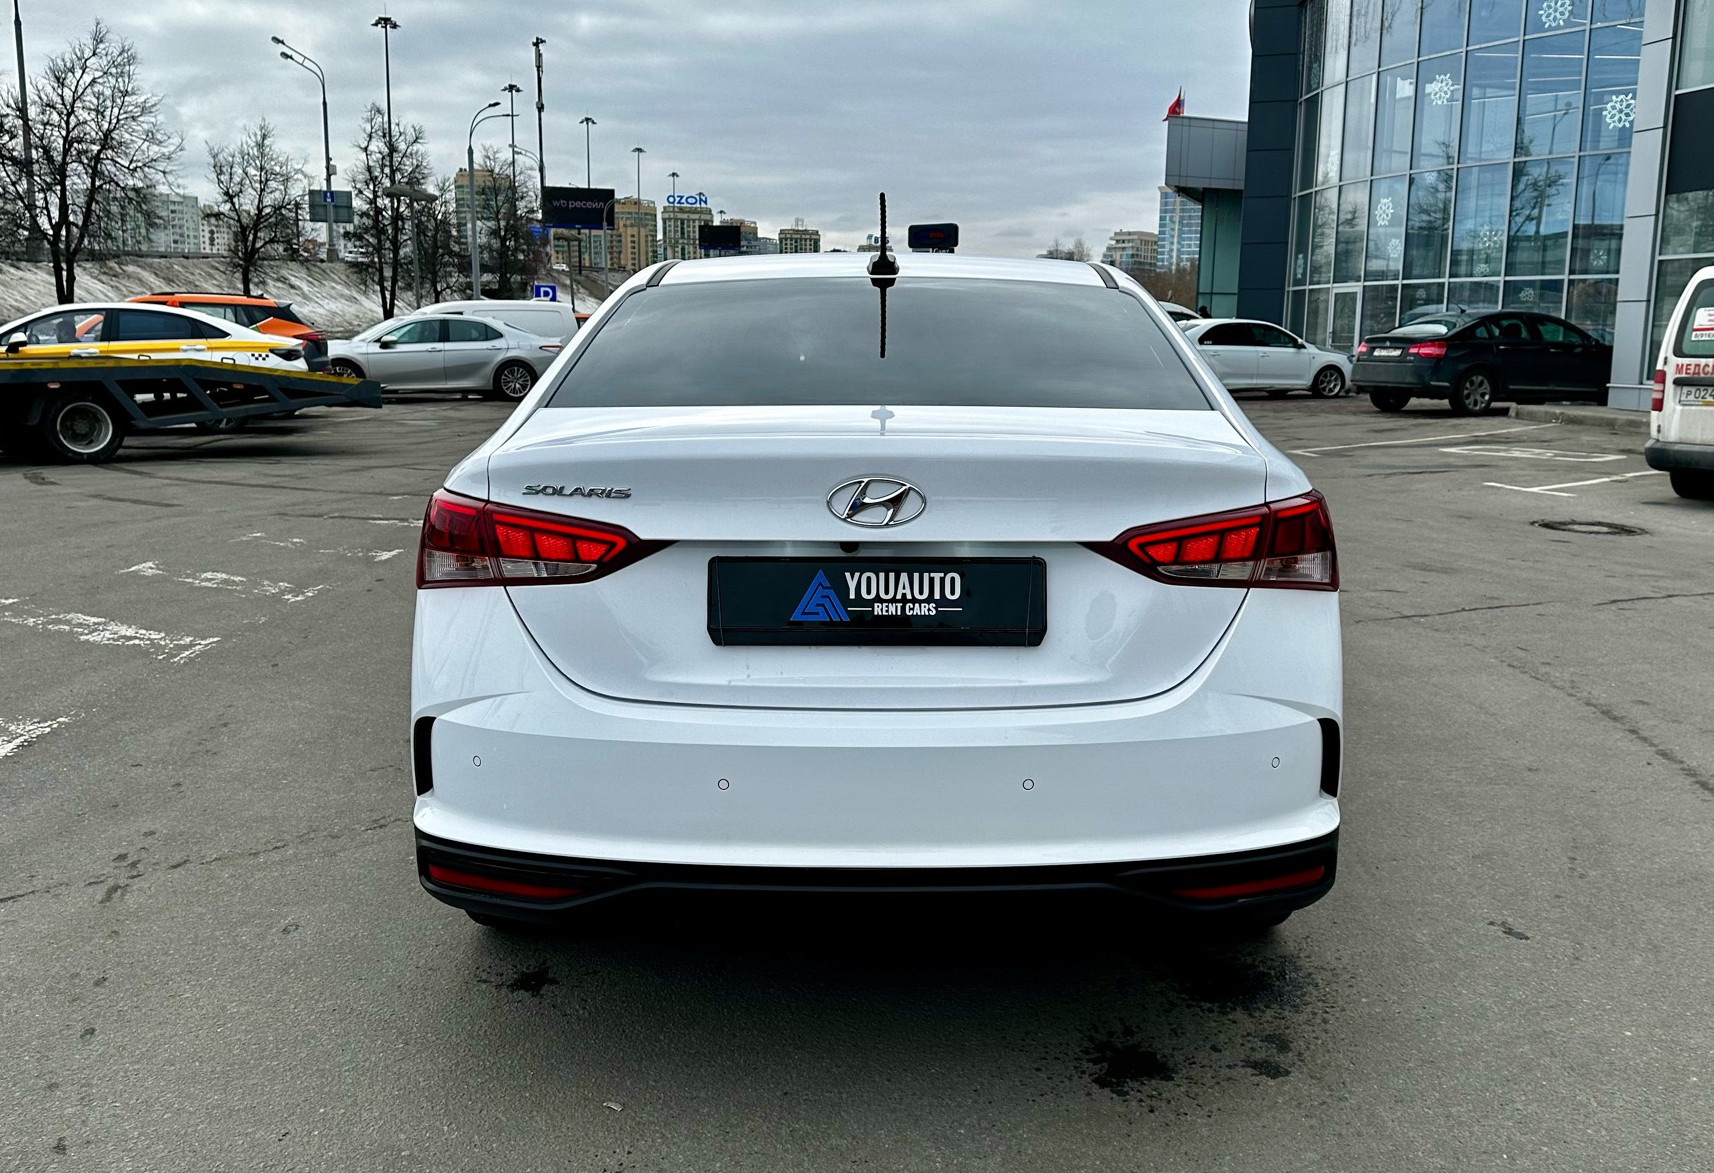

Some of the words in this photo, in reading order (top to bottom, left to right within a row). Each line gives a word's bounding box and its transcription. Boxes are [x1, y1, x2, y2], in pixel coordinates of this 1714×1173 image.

[552, 199, 567, 208] wb
[568, 199, 605, 210] ресейл
[667, 194, 707, 206] OZON
[521, 484, 632, 499] SOLARIS
[845, 572, 961, 600] YOUAUTO
[873, 603, 902, 616] RENT
[905, 603, 937, 616] CARS
